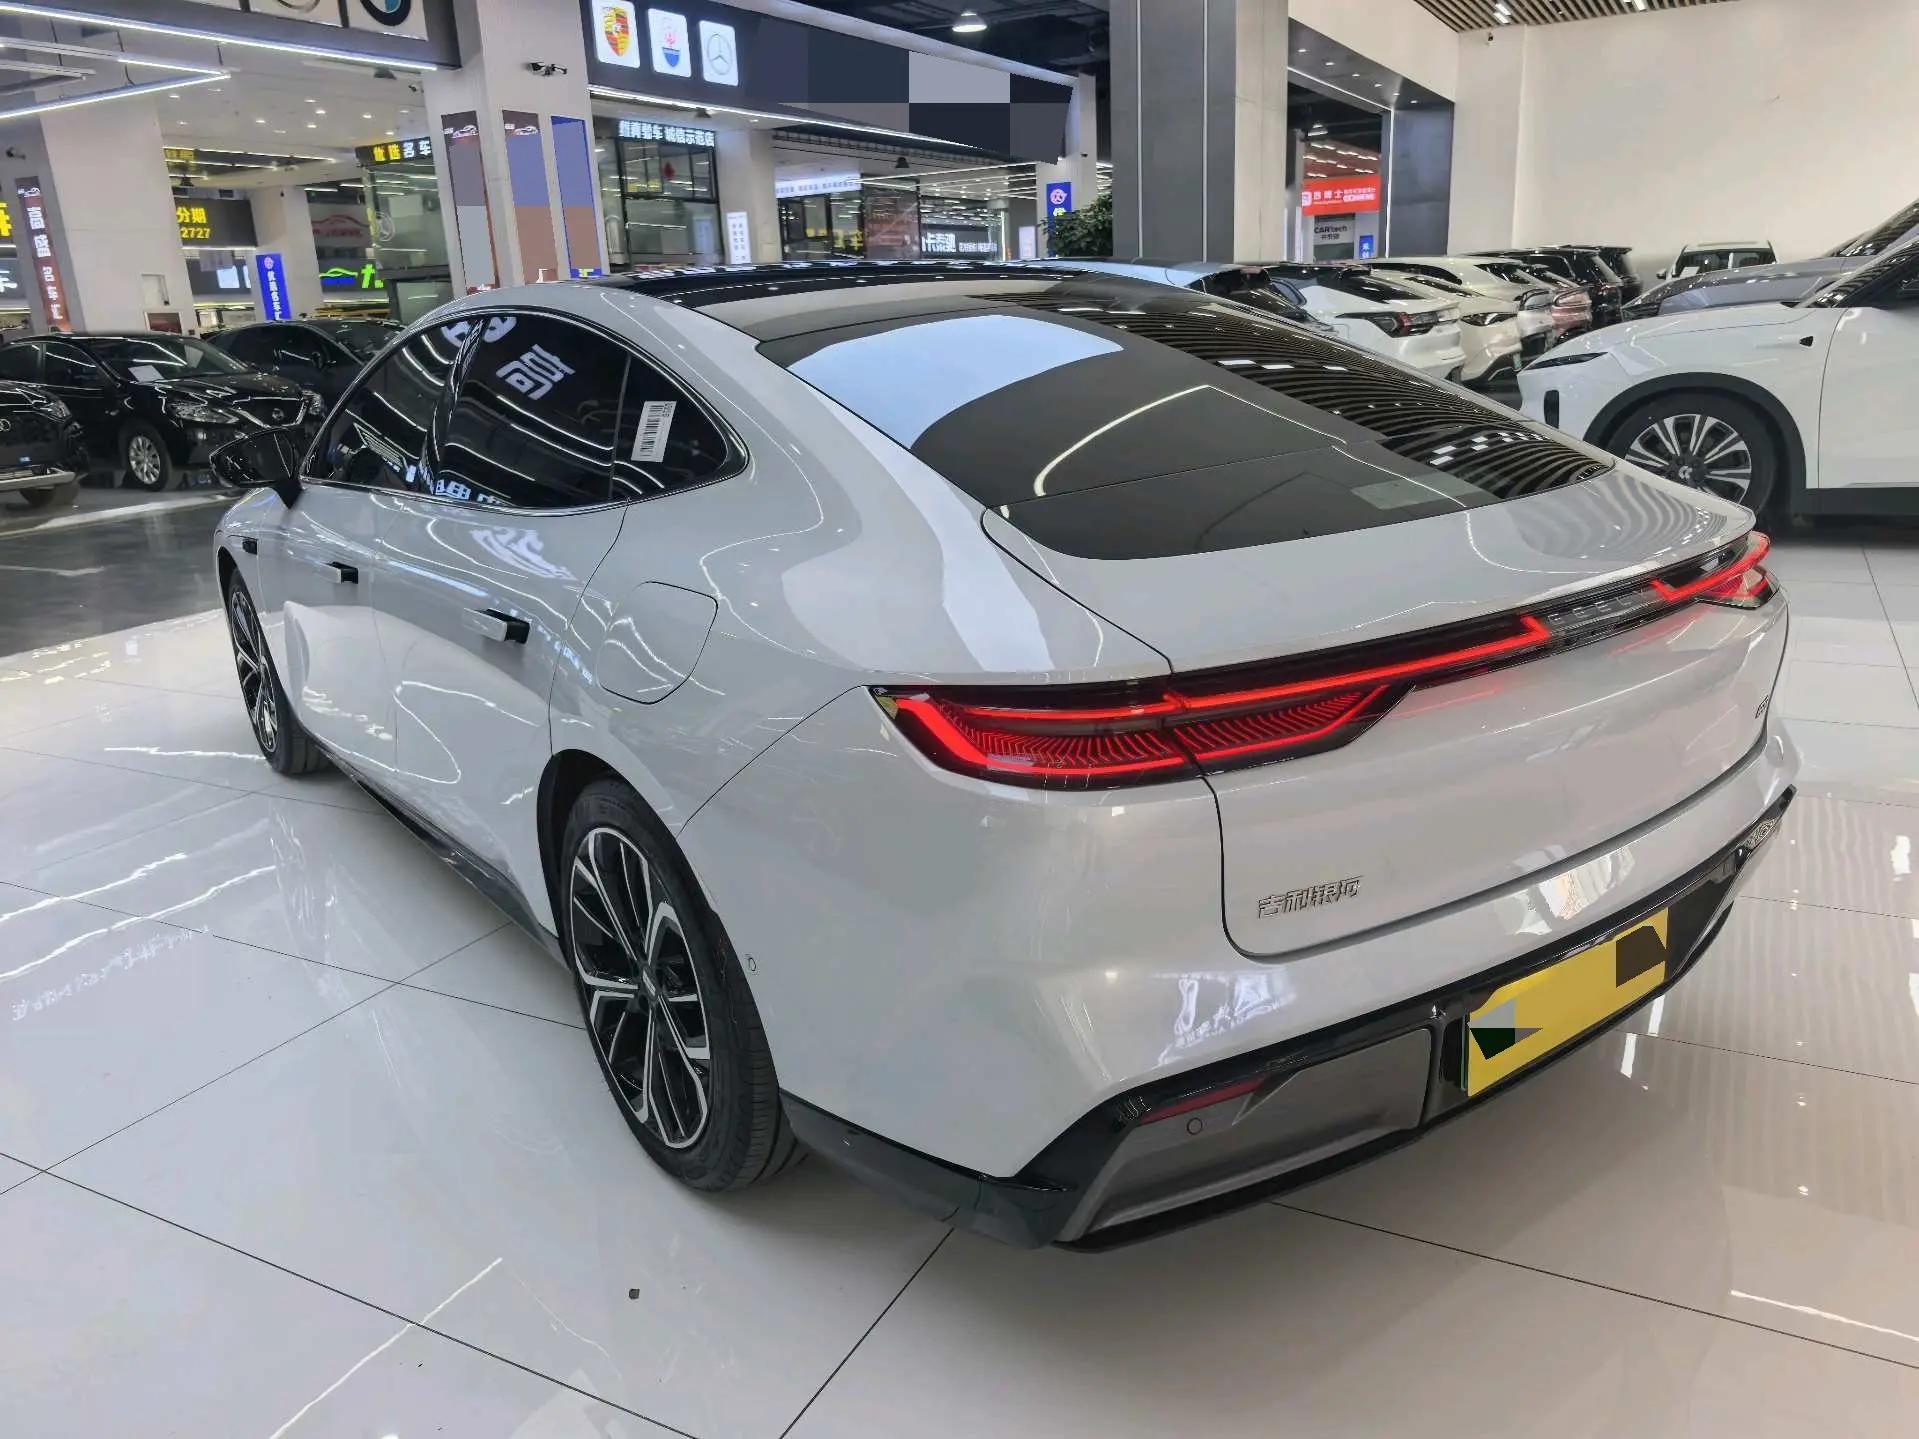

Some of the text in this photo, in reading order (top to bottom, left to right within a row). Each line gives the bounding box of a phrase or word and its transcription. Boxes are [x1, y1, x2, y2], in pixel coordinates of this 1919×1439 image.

[176, 207, 207, 223] 分期
[181, 227, 211, 239] 2727
[1257, 875, 1363, 919] 吉利银河
